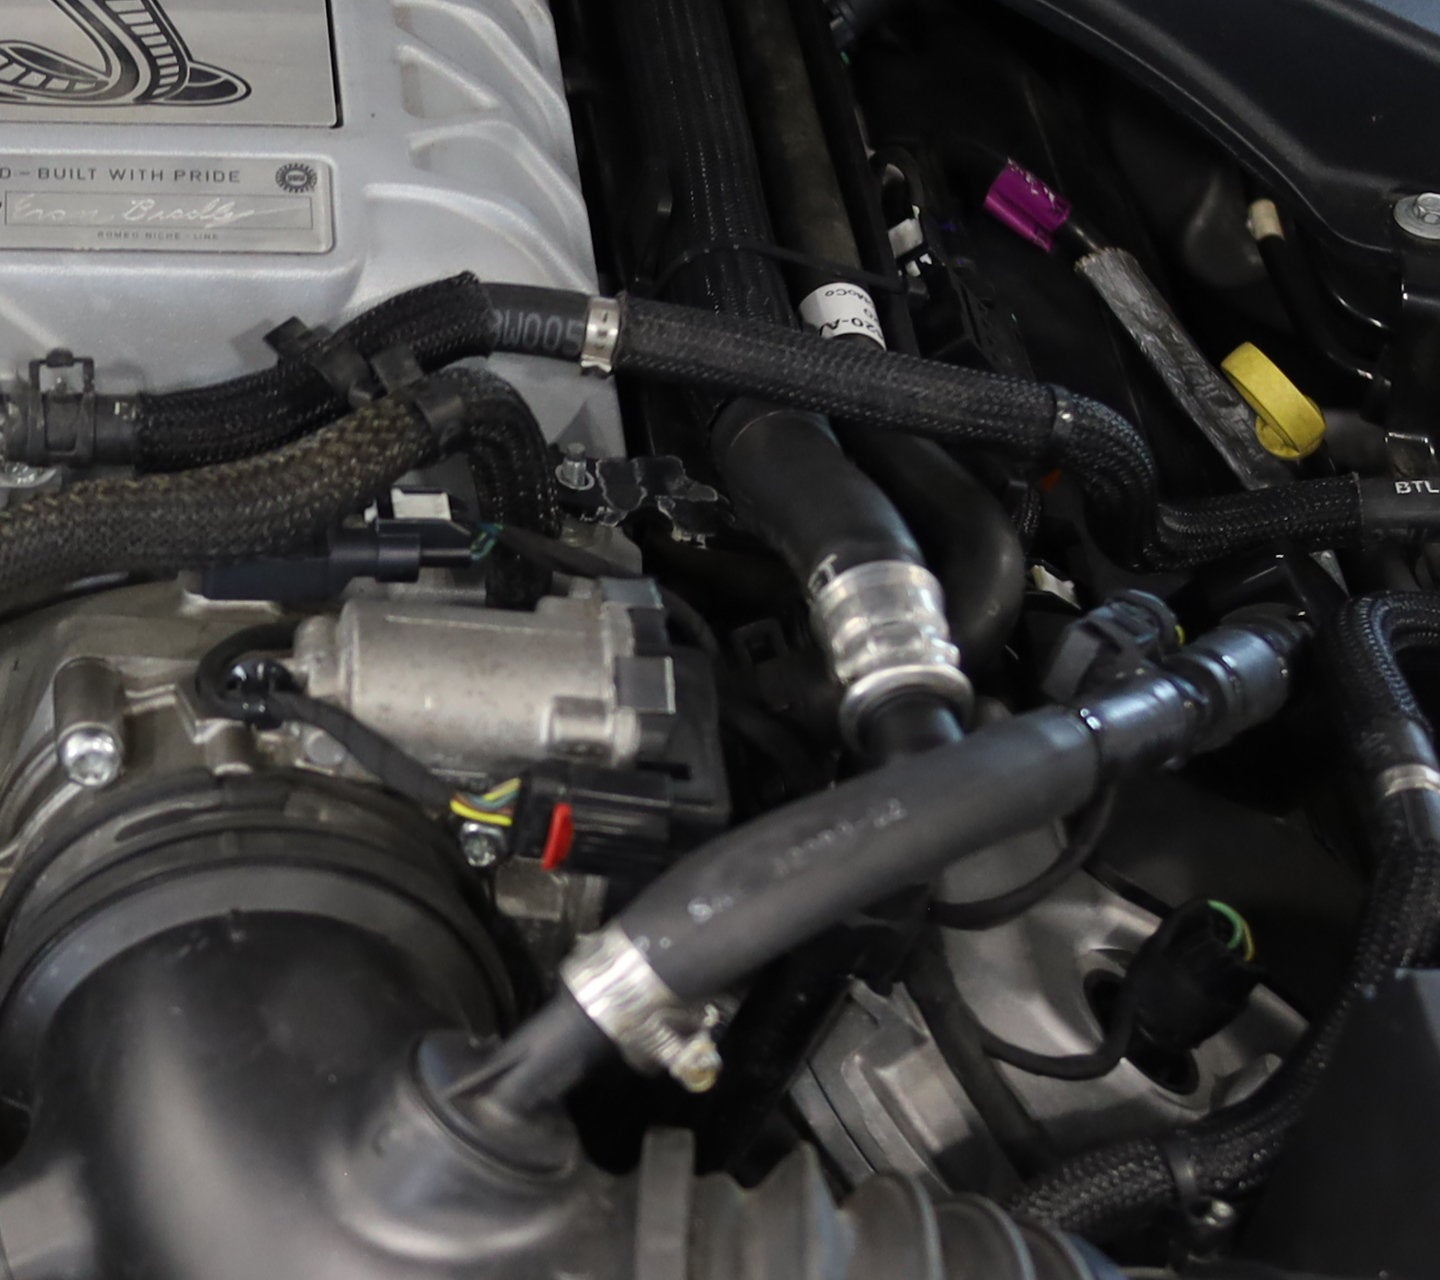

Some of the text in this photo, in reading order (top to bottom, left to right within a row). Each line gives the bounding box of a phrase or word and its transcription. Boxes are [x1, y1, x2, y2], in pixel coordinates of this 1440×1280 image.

[37, 167, 97, 181] BUILT
[108, 168, 164, 182] WITH
[173, 169, 241, 183] PRIDE
[1394, 480, 1440, 495] BTL
